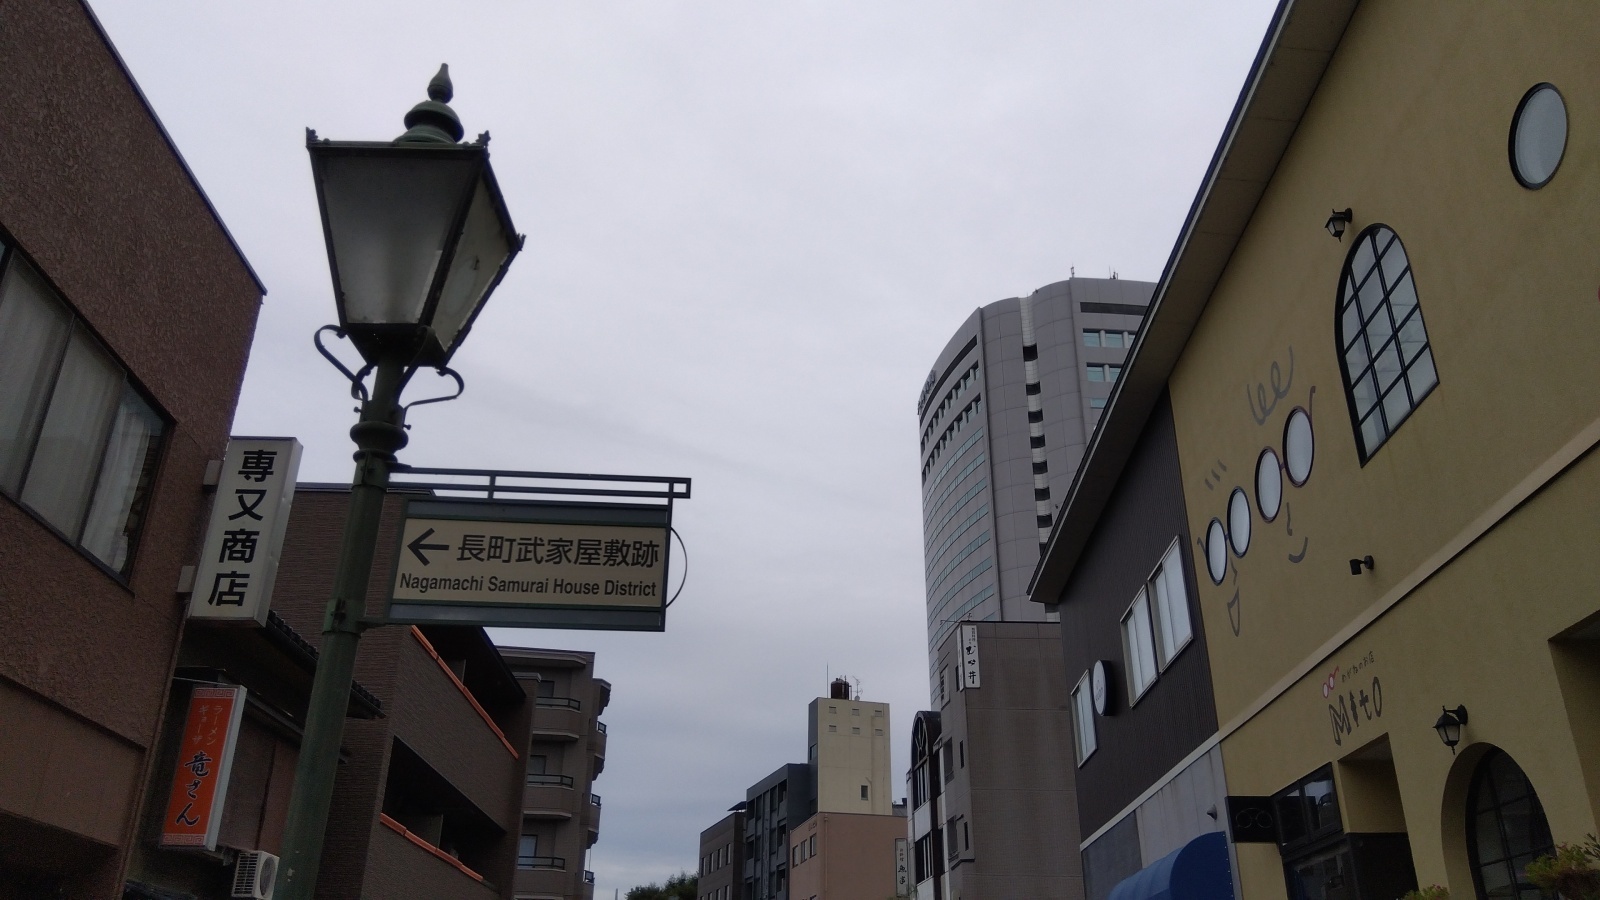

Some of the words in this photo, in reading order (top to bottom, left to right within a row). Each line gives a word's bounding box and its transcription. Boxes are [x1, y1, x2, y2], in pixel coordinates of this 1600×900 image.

[207, 449, 278, 607] 専又商店
[456, 533, 660, 569] 長町武家屋敷跡
[399, 572, 484, 594] Nagamachi
[488, 576, 549, 595] Samurai
[553, 578, 600, 596] House
[604, 580, 657, 598] District
[192, 704, 210, 746] ギョーザ
[206, 704, 224, 747] ラーメン
[174, 751, 214, 828] 竜さん
